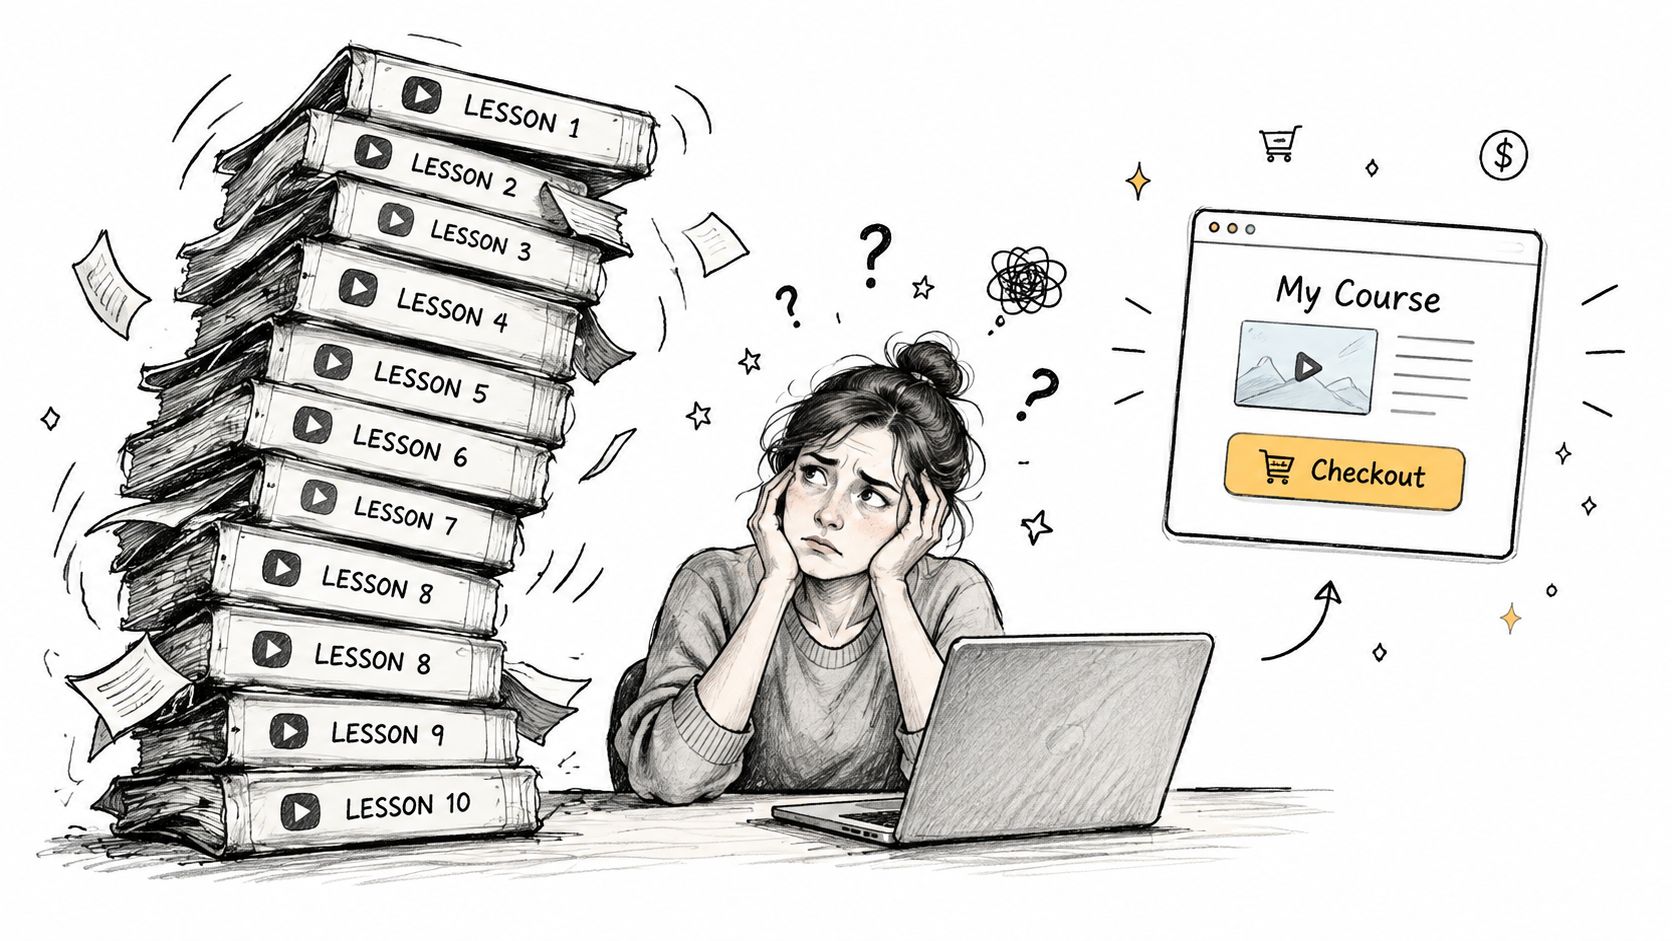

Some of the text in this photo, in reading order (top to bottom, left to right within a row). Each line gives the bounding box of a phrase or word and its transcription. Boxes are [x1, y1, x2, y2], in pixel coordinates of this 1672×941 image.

[463, 93, 580, 139] LESSON 1
[411, 152, 517, 198] LESSON 2
[430, 219, 531, 262] LESSON 3
[397, 287, 508, 334] LESSON 4
[1276, 274, 1441, 314] My Course
[374, 360, 490, 404] LESSON 5
[353, 423, 468, 468] LESSON 6
[1311, 458, 1426, 489] Checkout
[354, 495, 458, 536] LESSON 7
[322, 564, 434, 605] LESSON 8
[314, 642, 431, 675] LESSON 8
[331, 721, 444, 747] LESSON 9
[346, 791, 471, 821] LESSON 10
